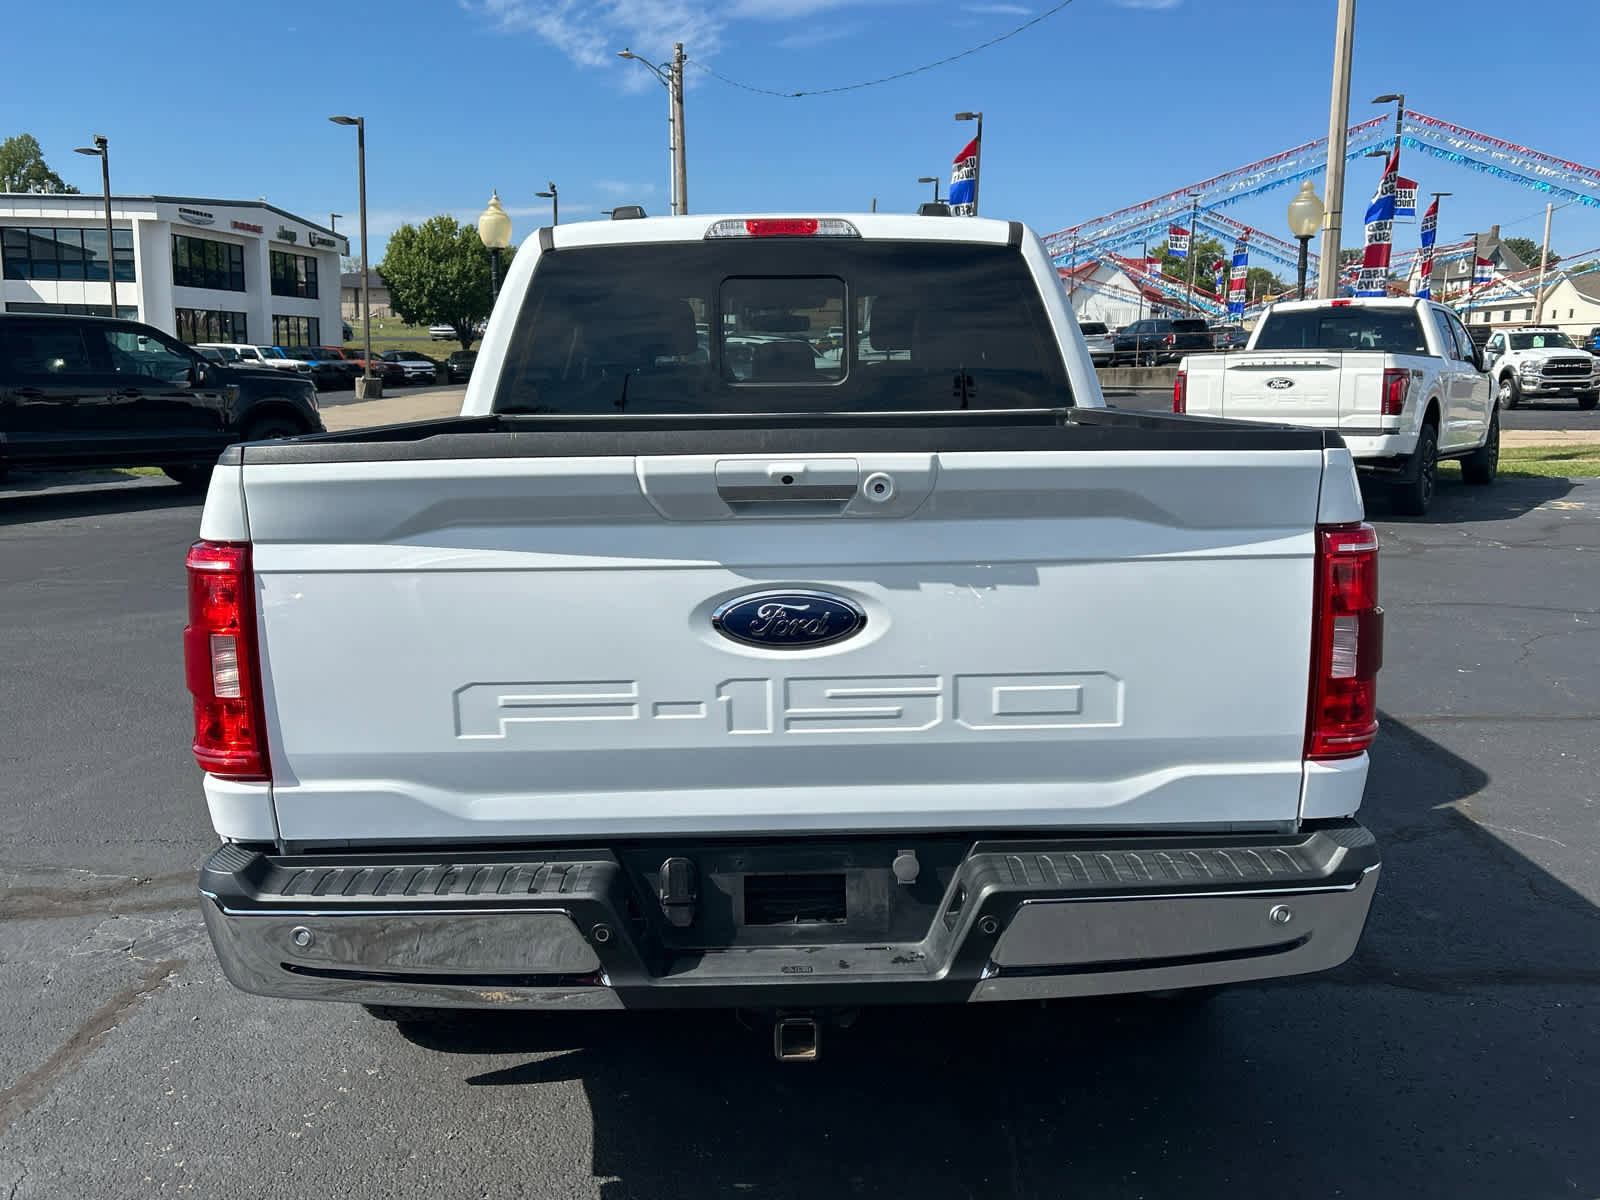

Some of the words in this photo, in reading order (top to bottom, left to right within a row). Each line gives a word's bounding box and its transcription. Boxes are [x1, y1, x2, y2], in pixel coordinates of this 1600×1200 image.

[1270, 379, 1291, 389] Ford
[750, 603, 831, 636] Ford
[452, 670, 1125, 740] F-150
